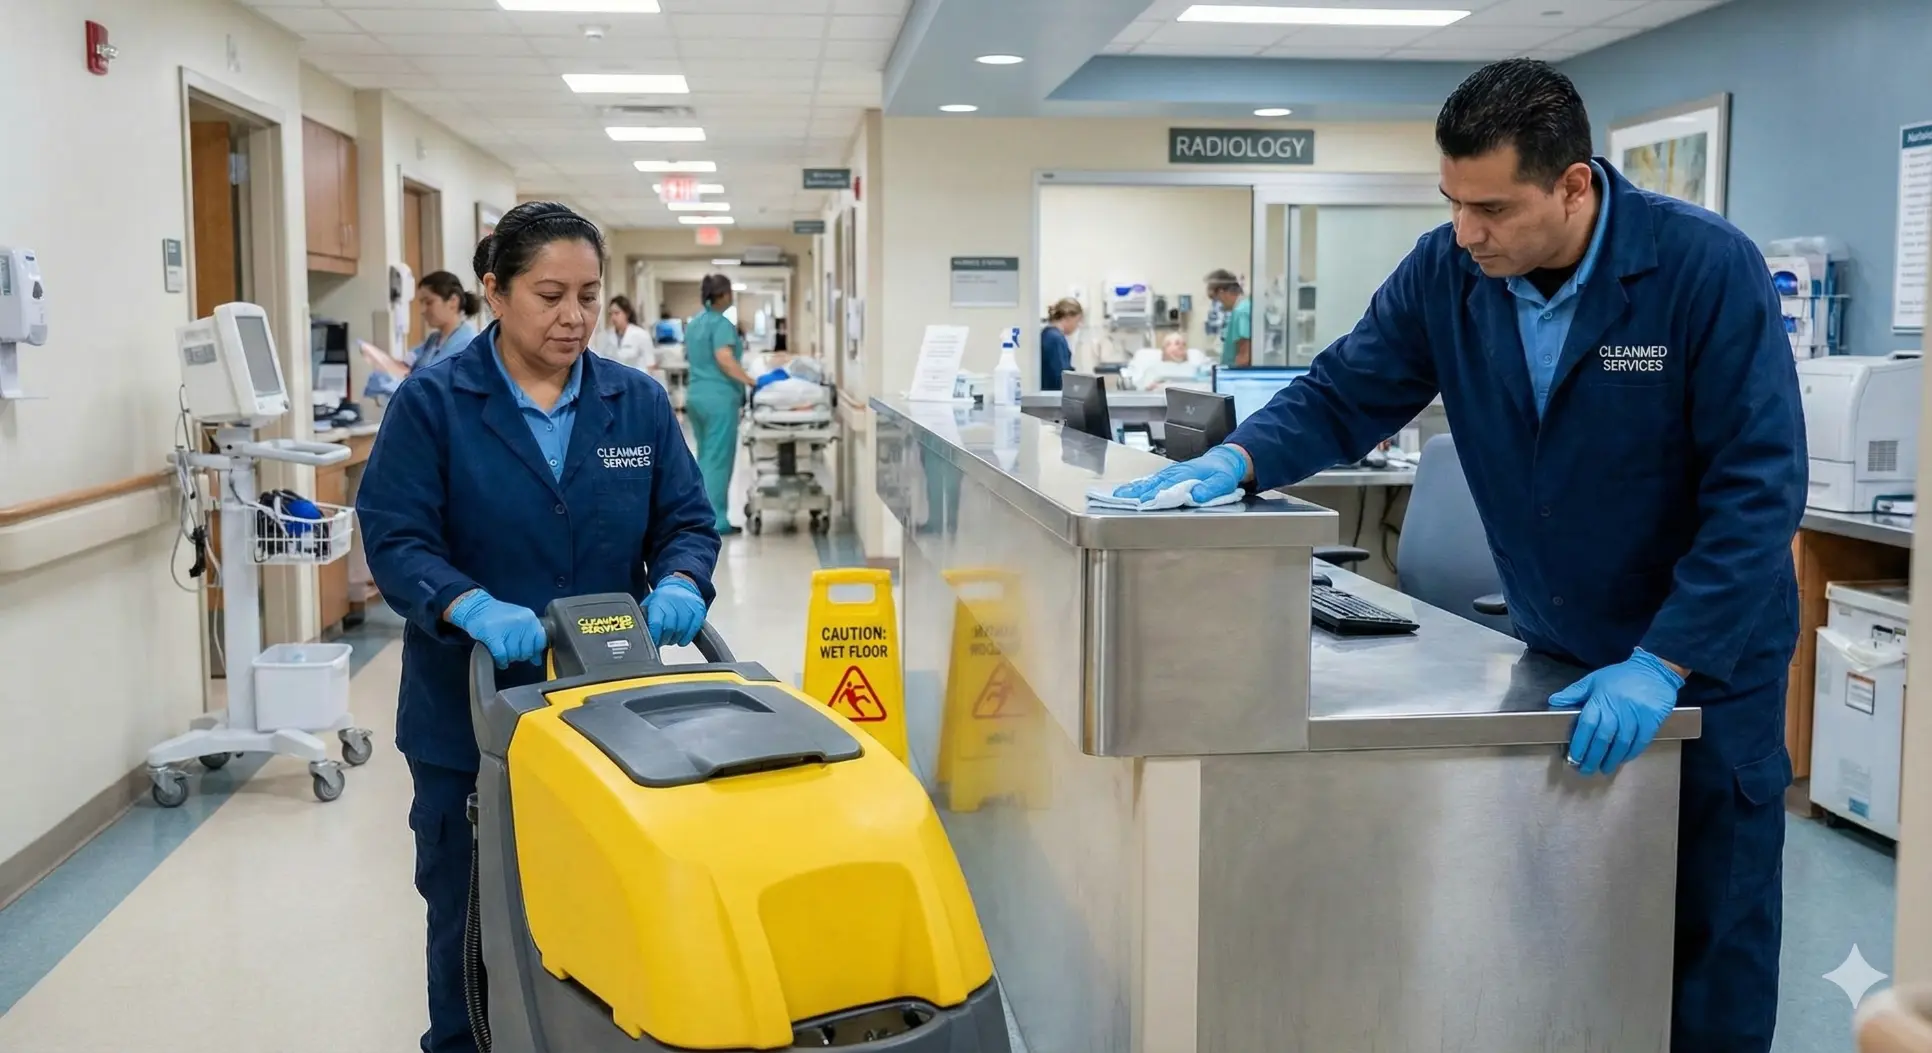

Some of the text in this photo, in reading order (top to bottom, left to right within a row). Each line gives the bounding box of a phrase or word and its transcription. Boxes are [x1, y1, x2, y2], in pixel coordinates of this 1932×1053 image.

[1176, 136, 1306, 158] RADIOLOGY
[1599, 345, 1668, 358] CLEANMED
[1603, 359, 1664, 371] SERVICES
[603, 456, 651, 469] SERVICES
[821, 626, 887, 641] CAUTION:
[820, 645, 888, 659] WET FLOOR
